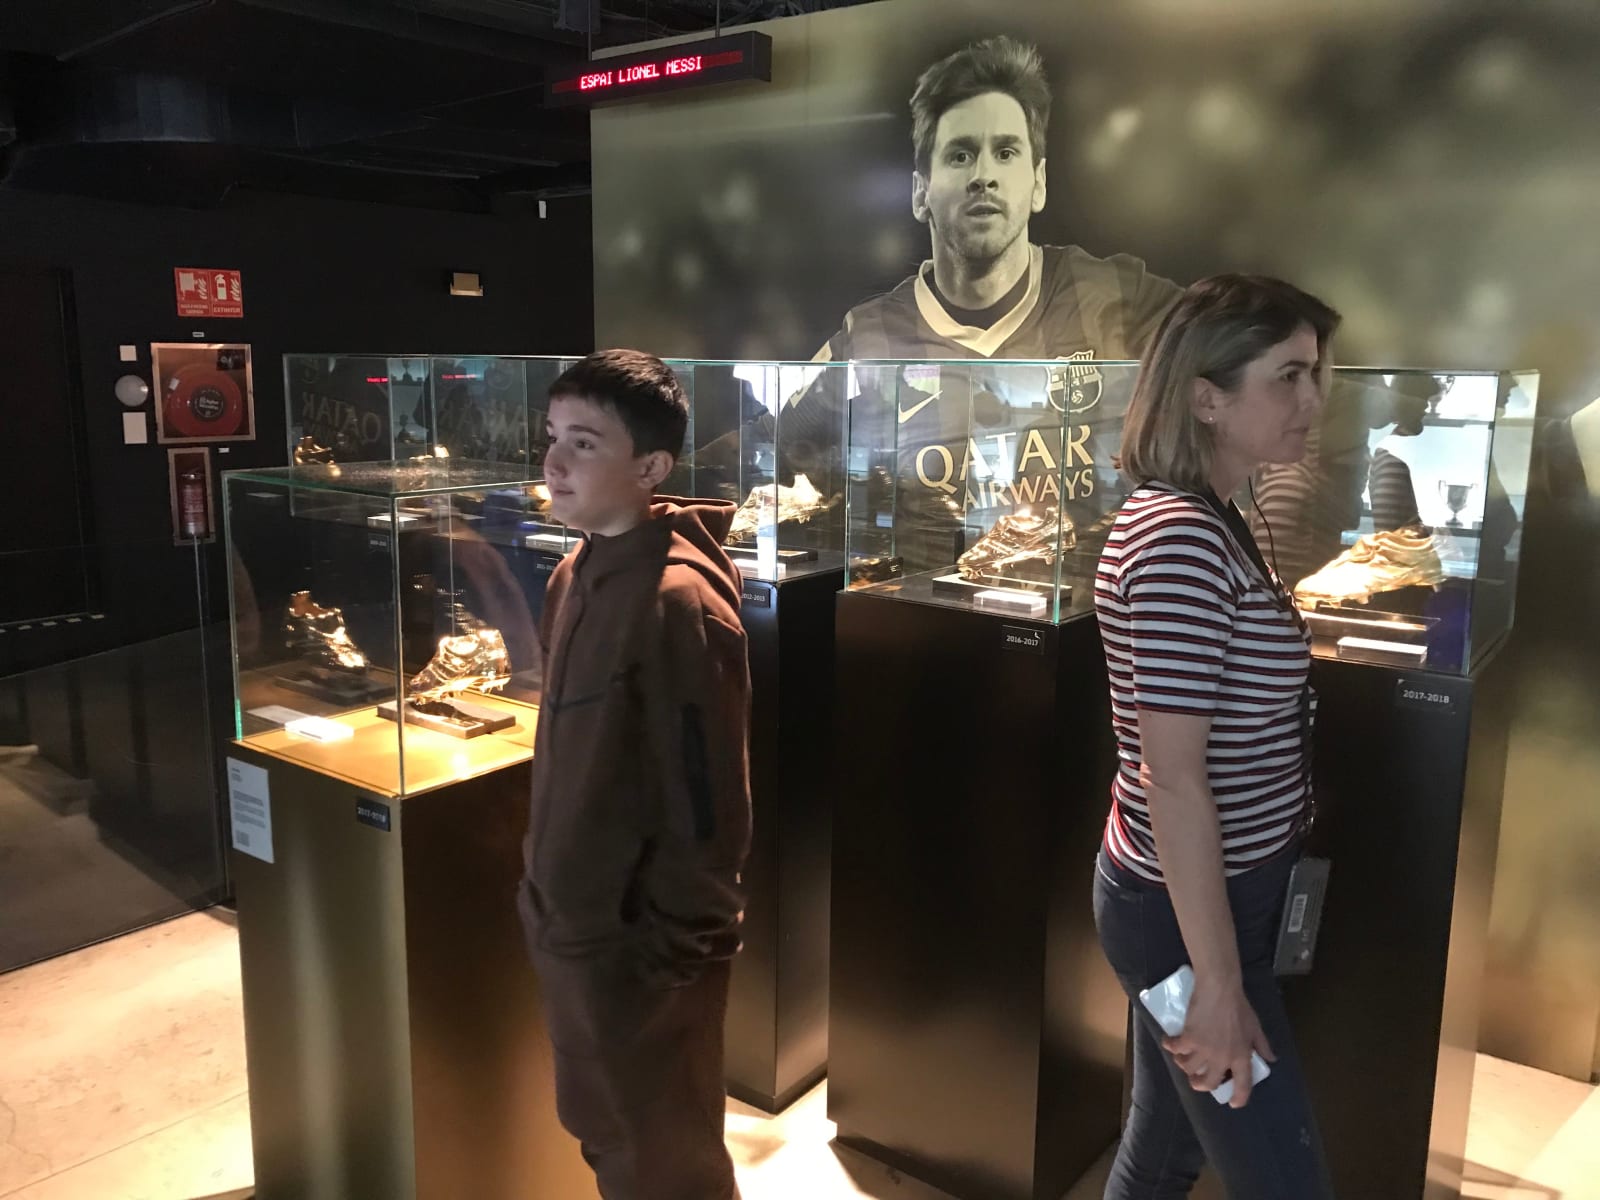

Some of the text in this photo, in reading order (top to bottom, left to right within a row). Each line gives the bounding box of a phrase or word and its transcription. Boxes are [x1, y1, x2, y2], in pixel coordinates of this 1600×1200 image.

[580, 56, 702, 89] ESPAI LIONEL MESSI
[915, 424, 1095, 494] QATAR
[961, 468, 1094, 512] AIRWAYS
[1006, 634, 1039, 647] 2016-2017
[1403, 690, 1449, 703] 2017-2018
